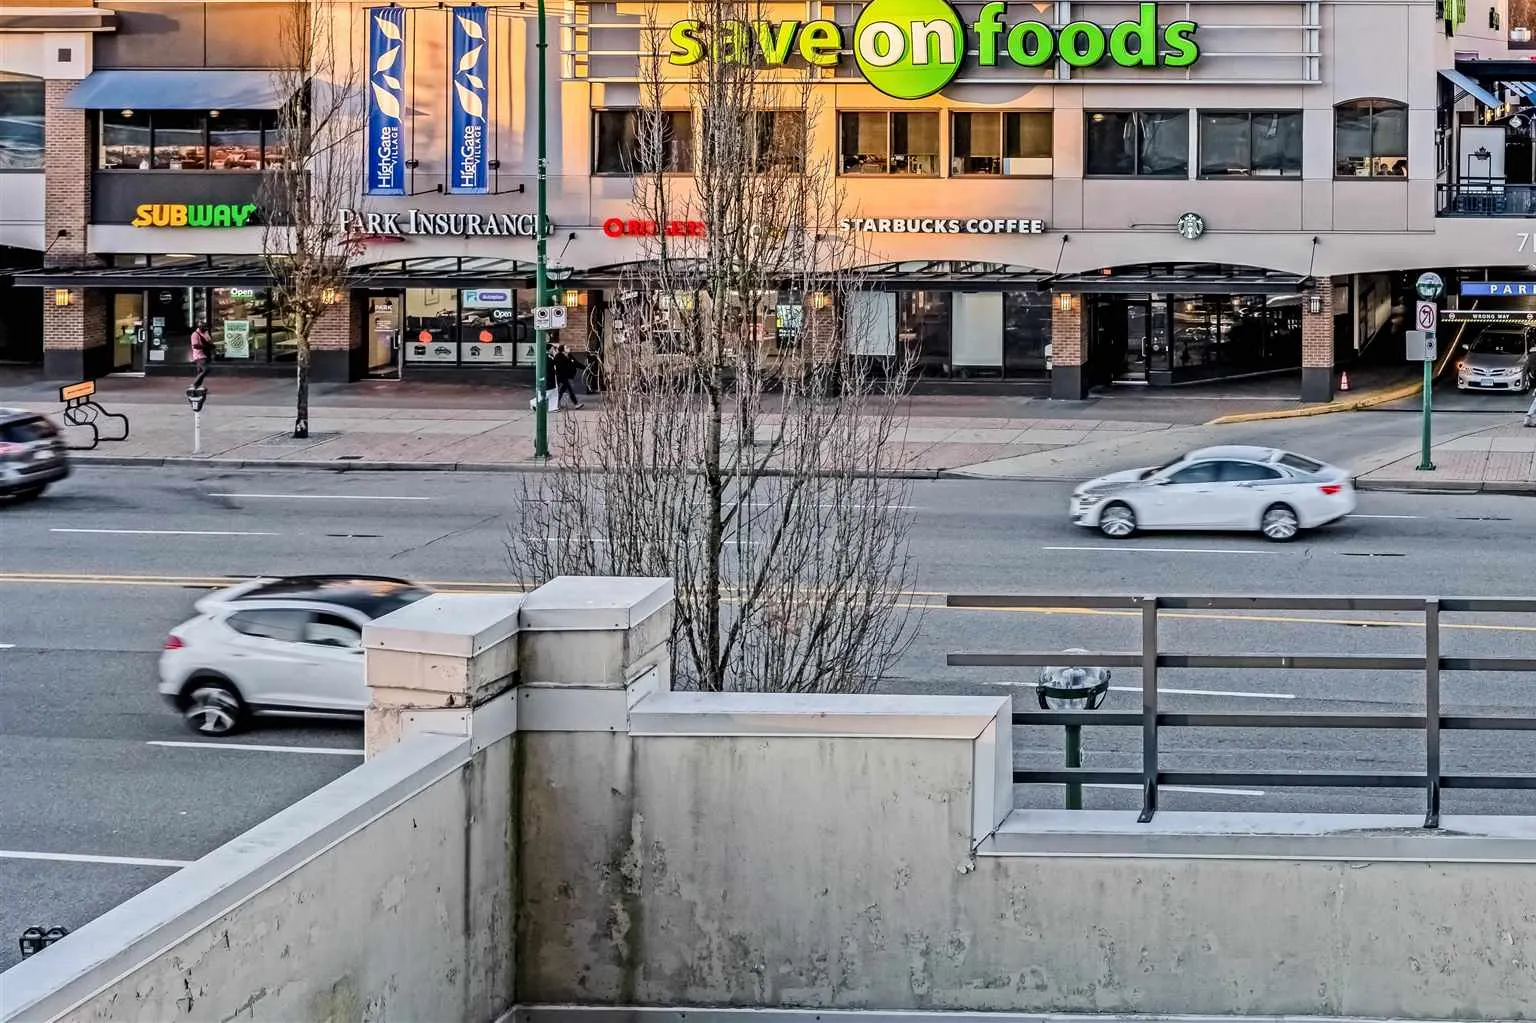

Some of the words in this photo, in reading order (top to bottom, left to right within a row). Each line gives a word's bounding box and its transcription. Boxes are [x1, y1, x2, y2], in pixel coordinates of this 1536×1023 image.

[669, 17, 844, 66] save
[858, 16, 957, 66] on
[973, 2, 1200, 68] foods
[377, 126, 394, 188] HighGate
[391, 127, 399, 166] VILLAGE
[460, 125, 476, 188] HighGate
[474, 126, 482, 165] VILLAGE
[132, 203, 257, 227] SUBWAY
[339, 208, 401, 234] PARK
[840, 219, 959, 234] STARBUCKS
[966, 219, 1044, 234] COFFEE
[230, 288, 253, 296] Open
[493, 309, 512, 319] Open
